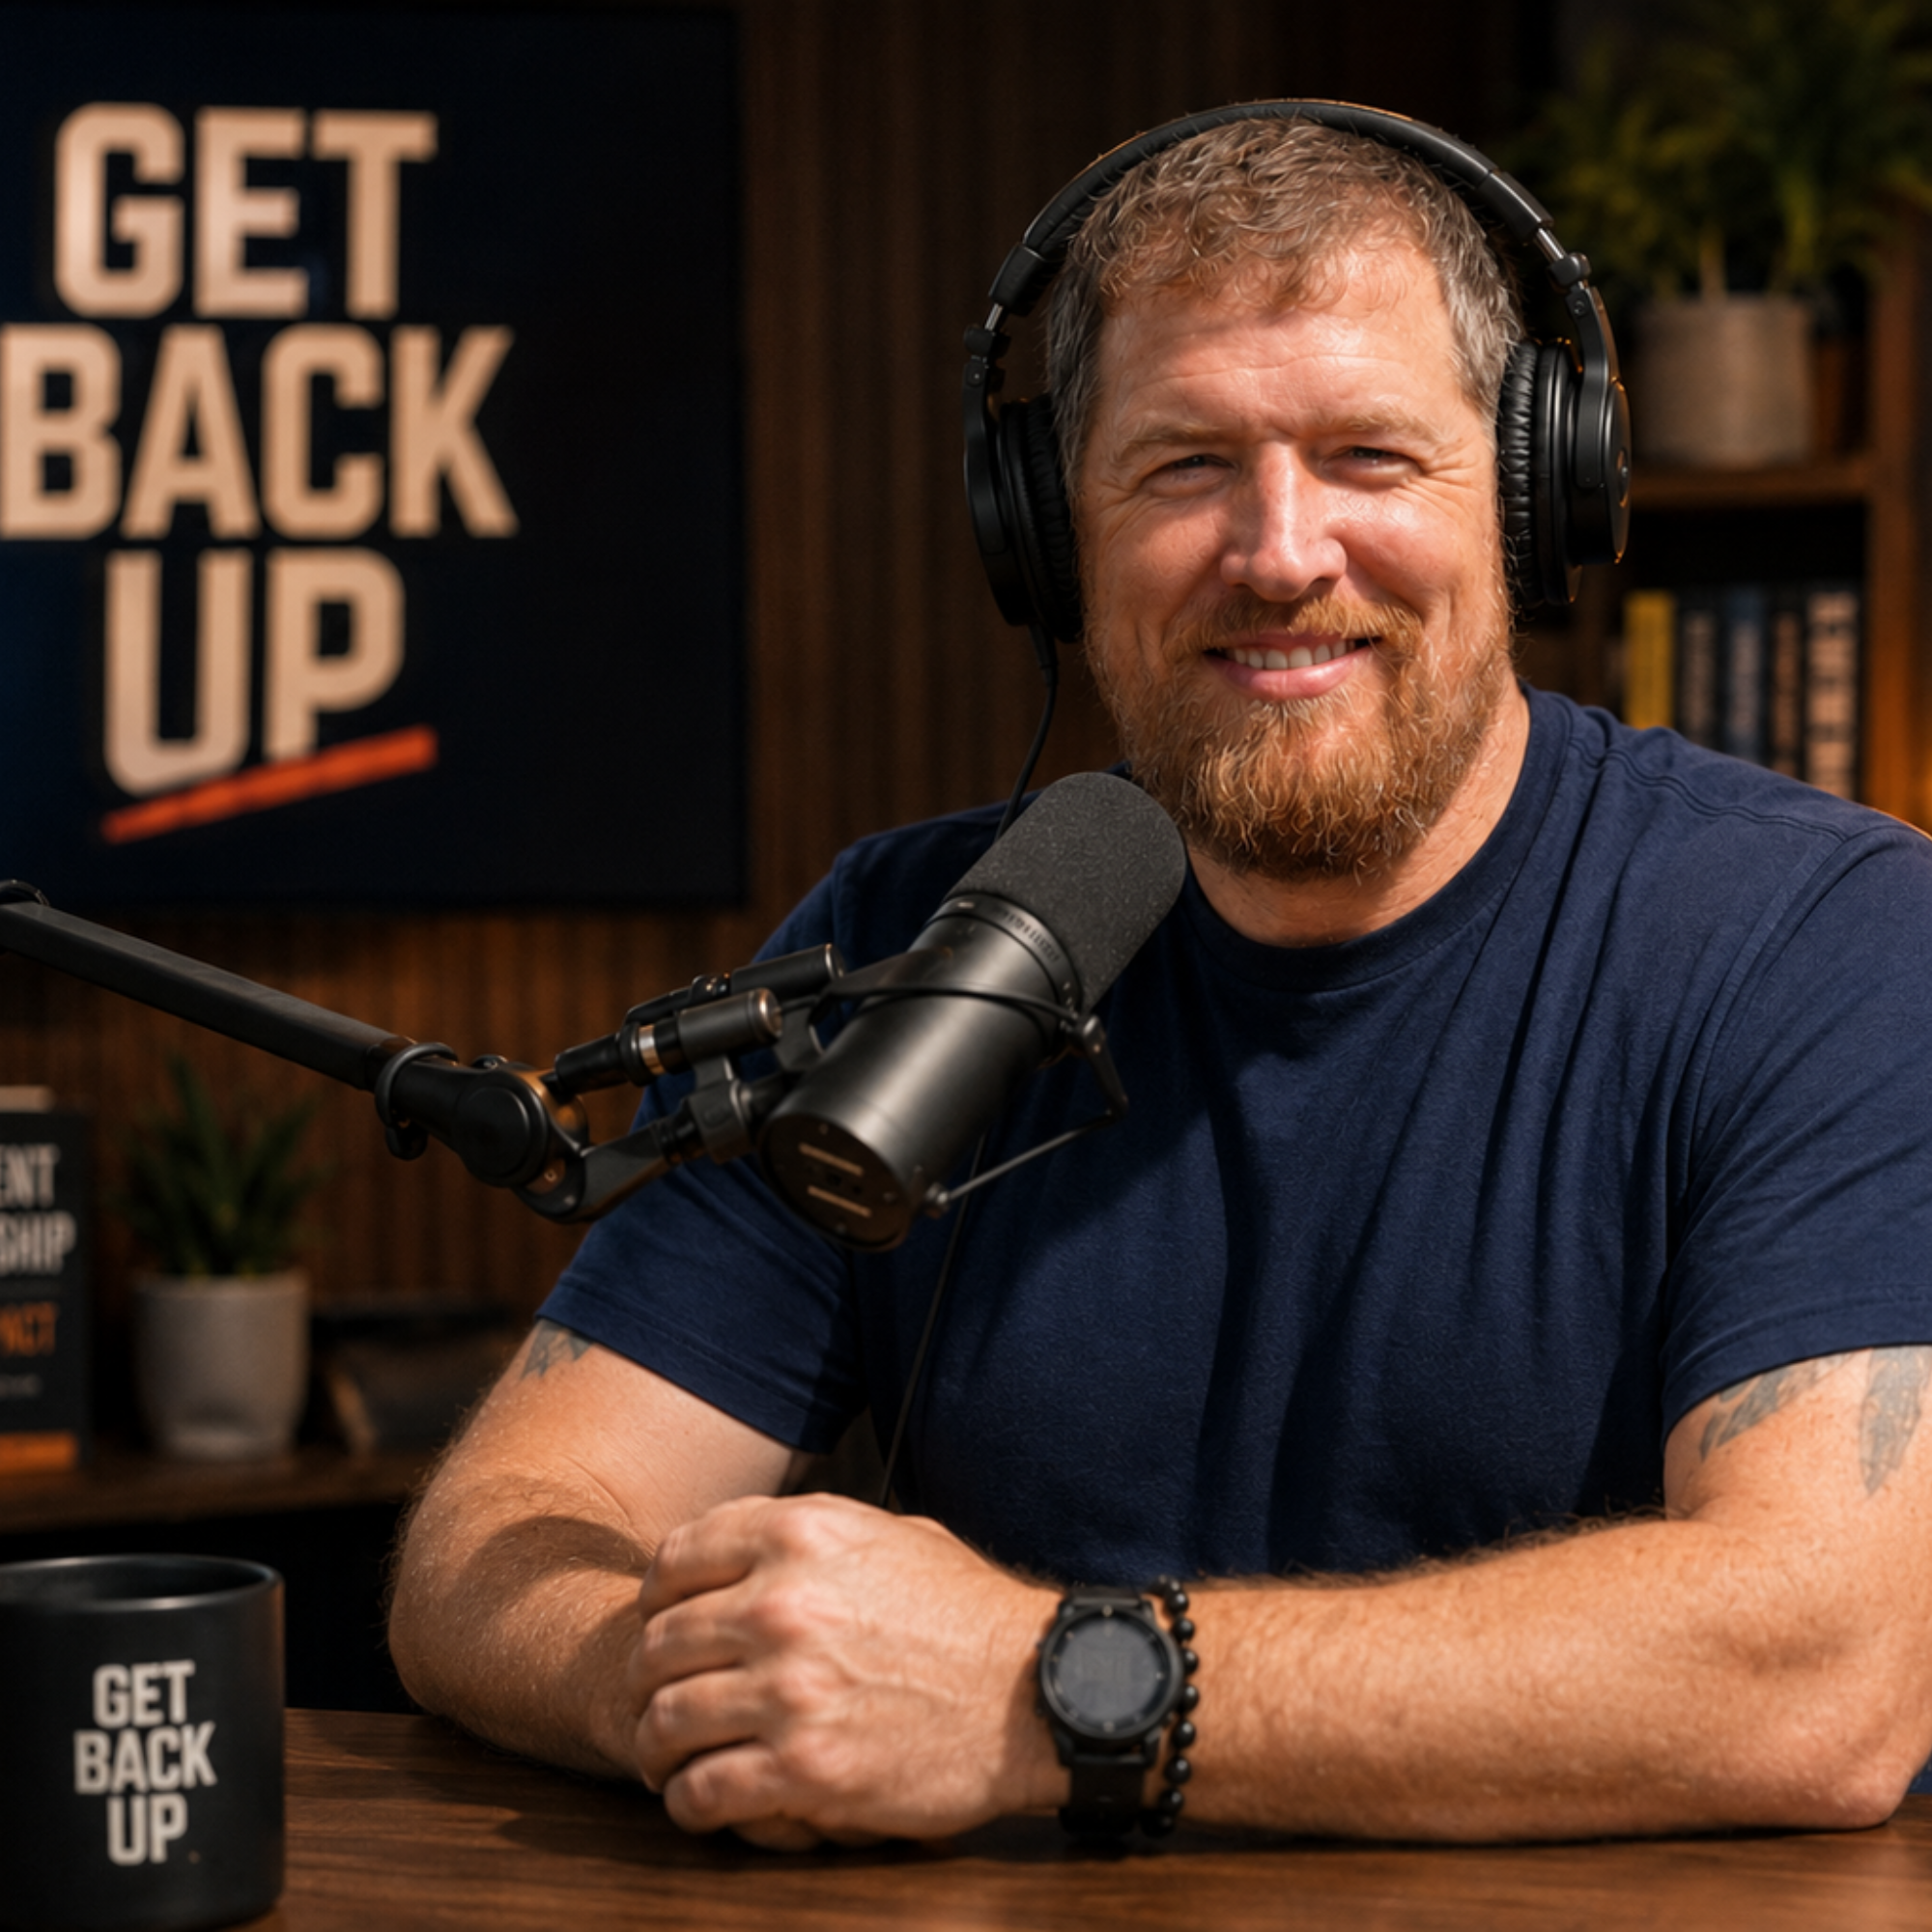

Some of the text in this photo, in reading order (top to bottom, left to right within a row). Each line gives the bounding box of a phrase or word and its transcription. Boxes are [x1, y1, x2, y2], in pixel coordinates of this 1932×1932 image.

[54, 101, 440, 319] GET
[0, 323, 520, 541] BACK
[103, 548, 406, 798] UP
[73, 1720, 217, 1795] BACK
[93, 1660, 195, 1729] GET
[106, 1792, 188, 1866] UP
